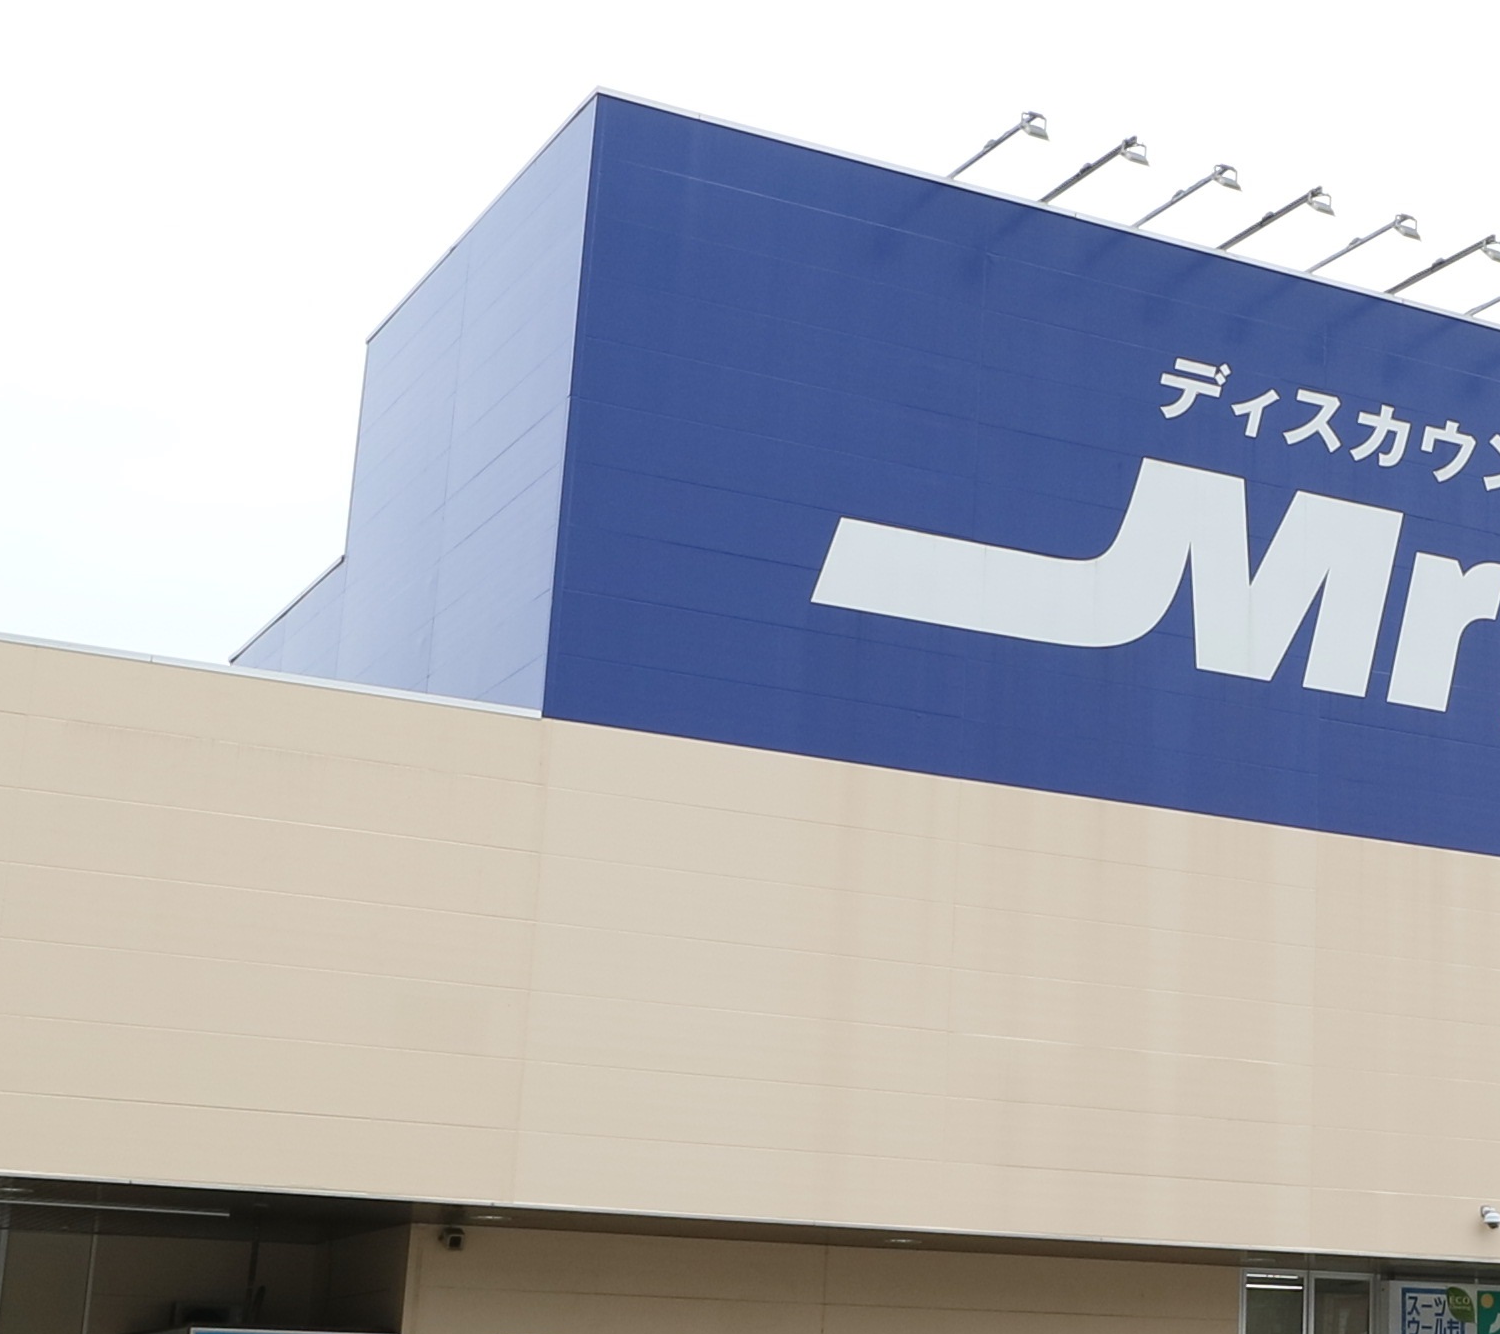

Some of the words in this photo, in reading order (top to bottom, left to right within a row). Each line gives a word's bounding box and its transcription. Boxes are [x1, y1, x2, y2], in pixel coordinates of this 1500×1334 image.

[1407, 1296, 1446, 1317] スーツ
[1449, 1296, 1471, 1305] ECO
